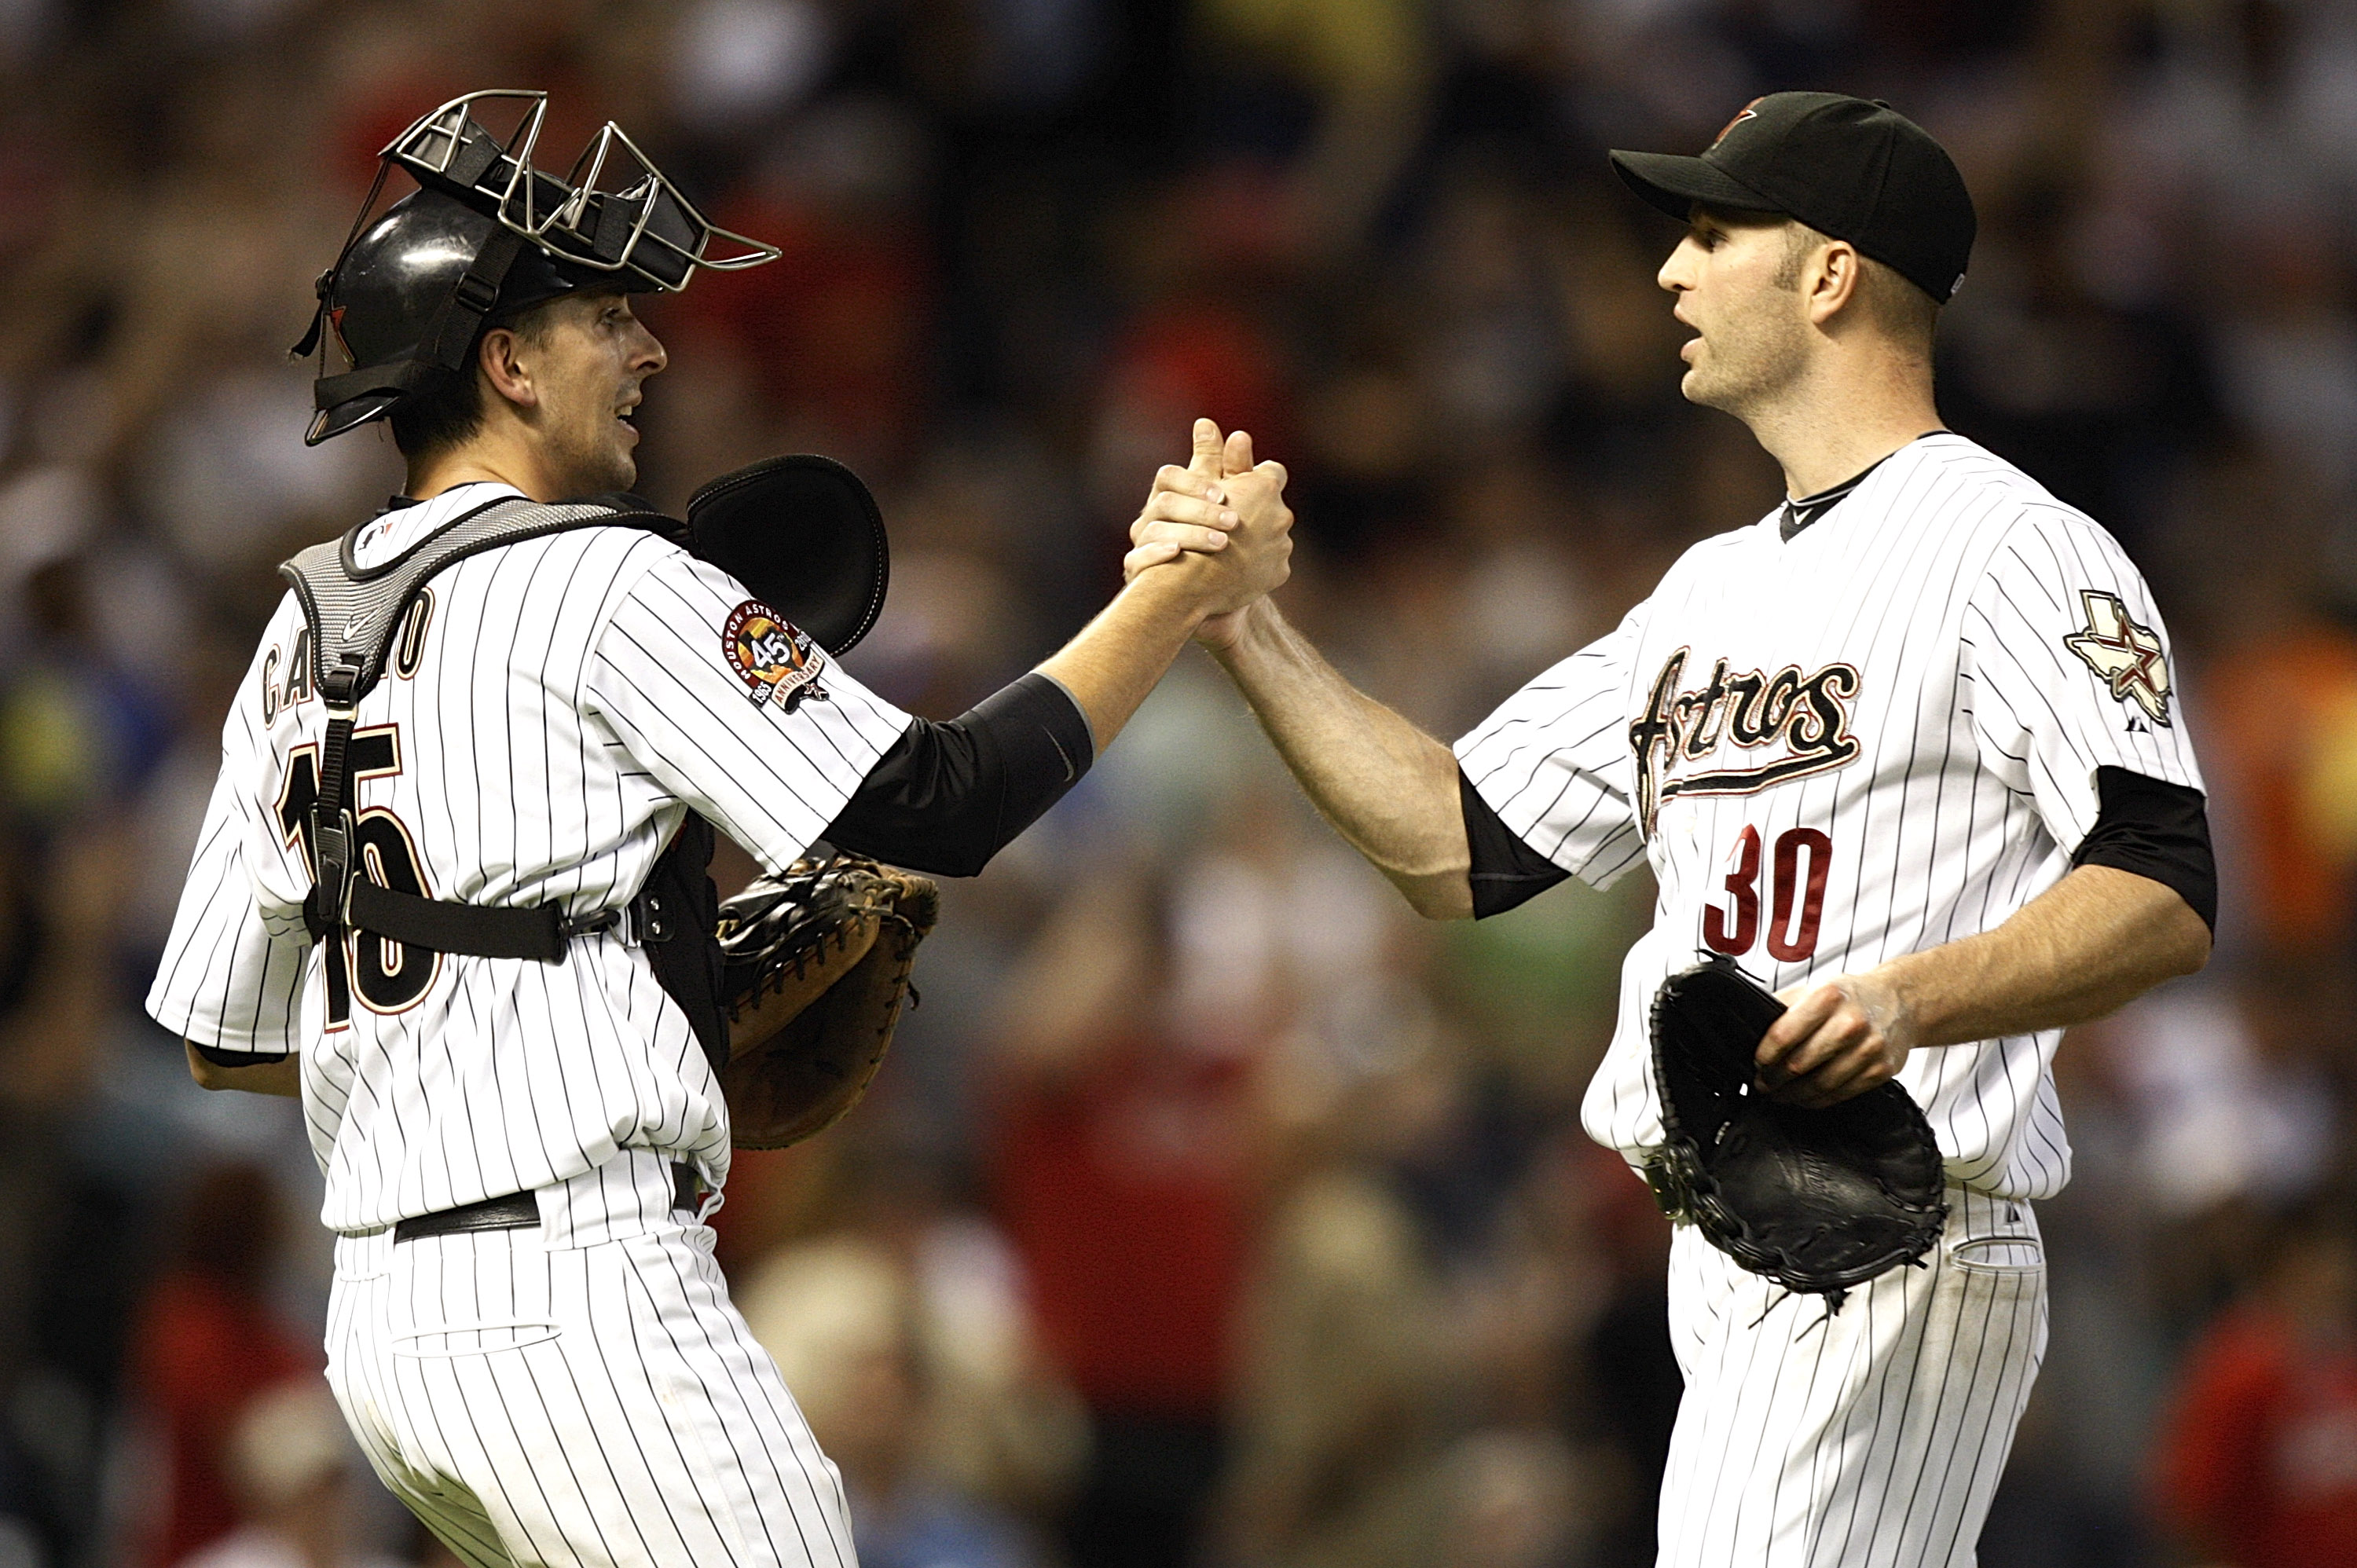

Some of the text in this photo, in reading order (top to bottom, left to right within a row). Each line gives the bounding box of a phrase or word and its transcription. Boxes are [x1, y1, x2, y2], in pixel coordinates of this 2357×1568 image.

[725, 603, 789, 680] HOUSTON ASTROS
[774, 655, 821, 704] ANNIVERSARY
[752, 681, 772, 703] 1965
[1629, 645, 1863, 837] Astros
[1703, 823, 1832, 962] 30
